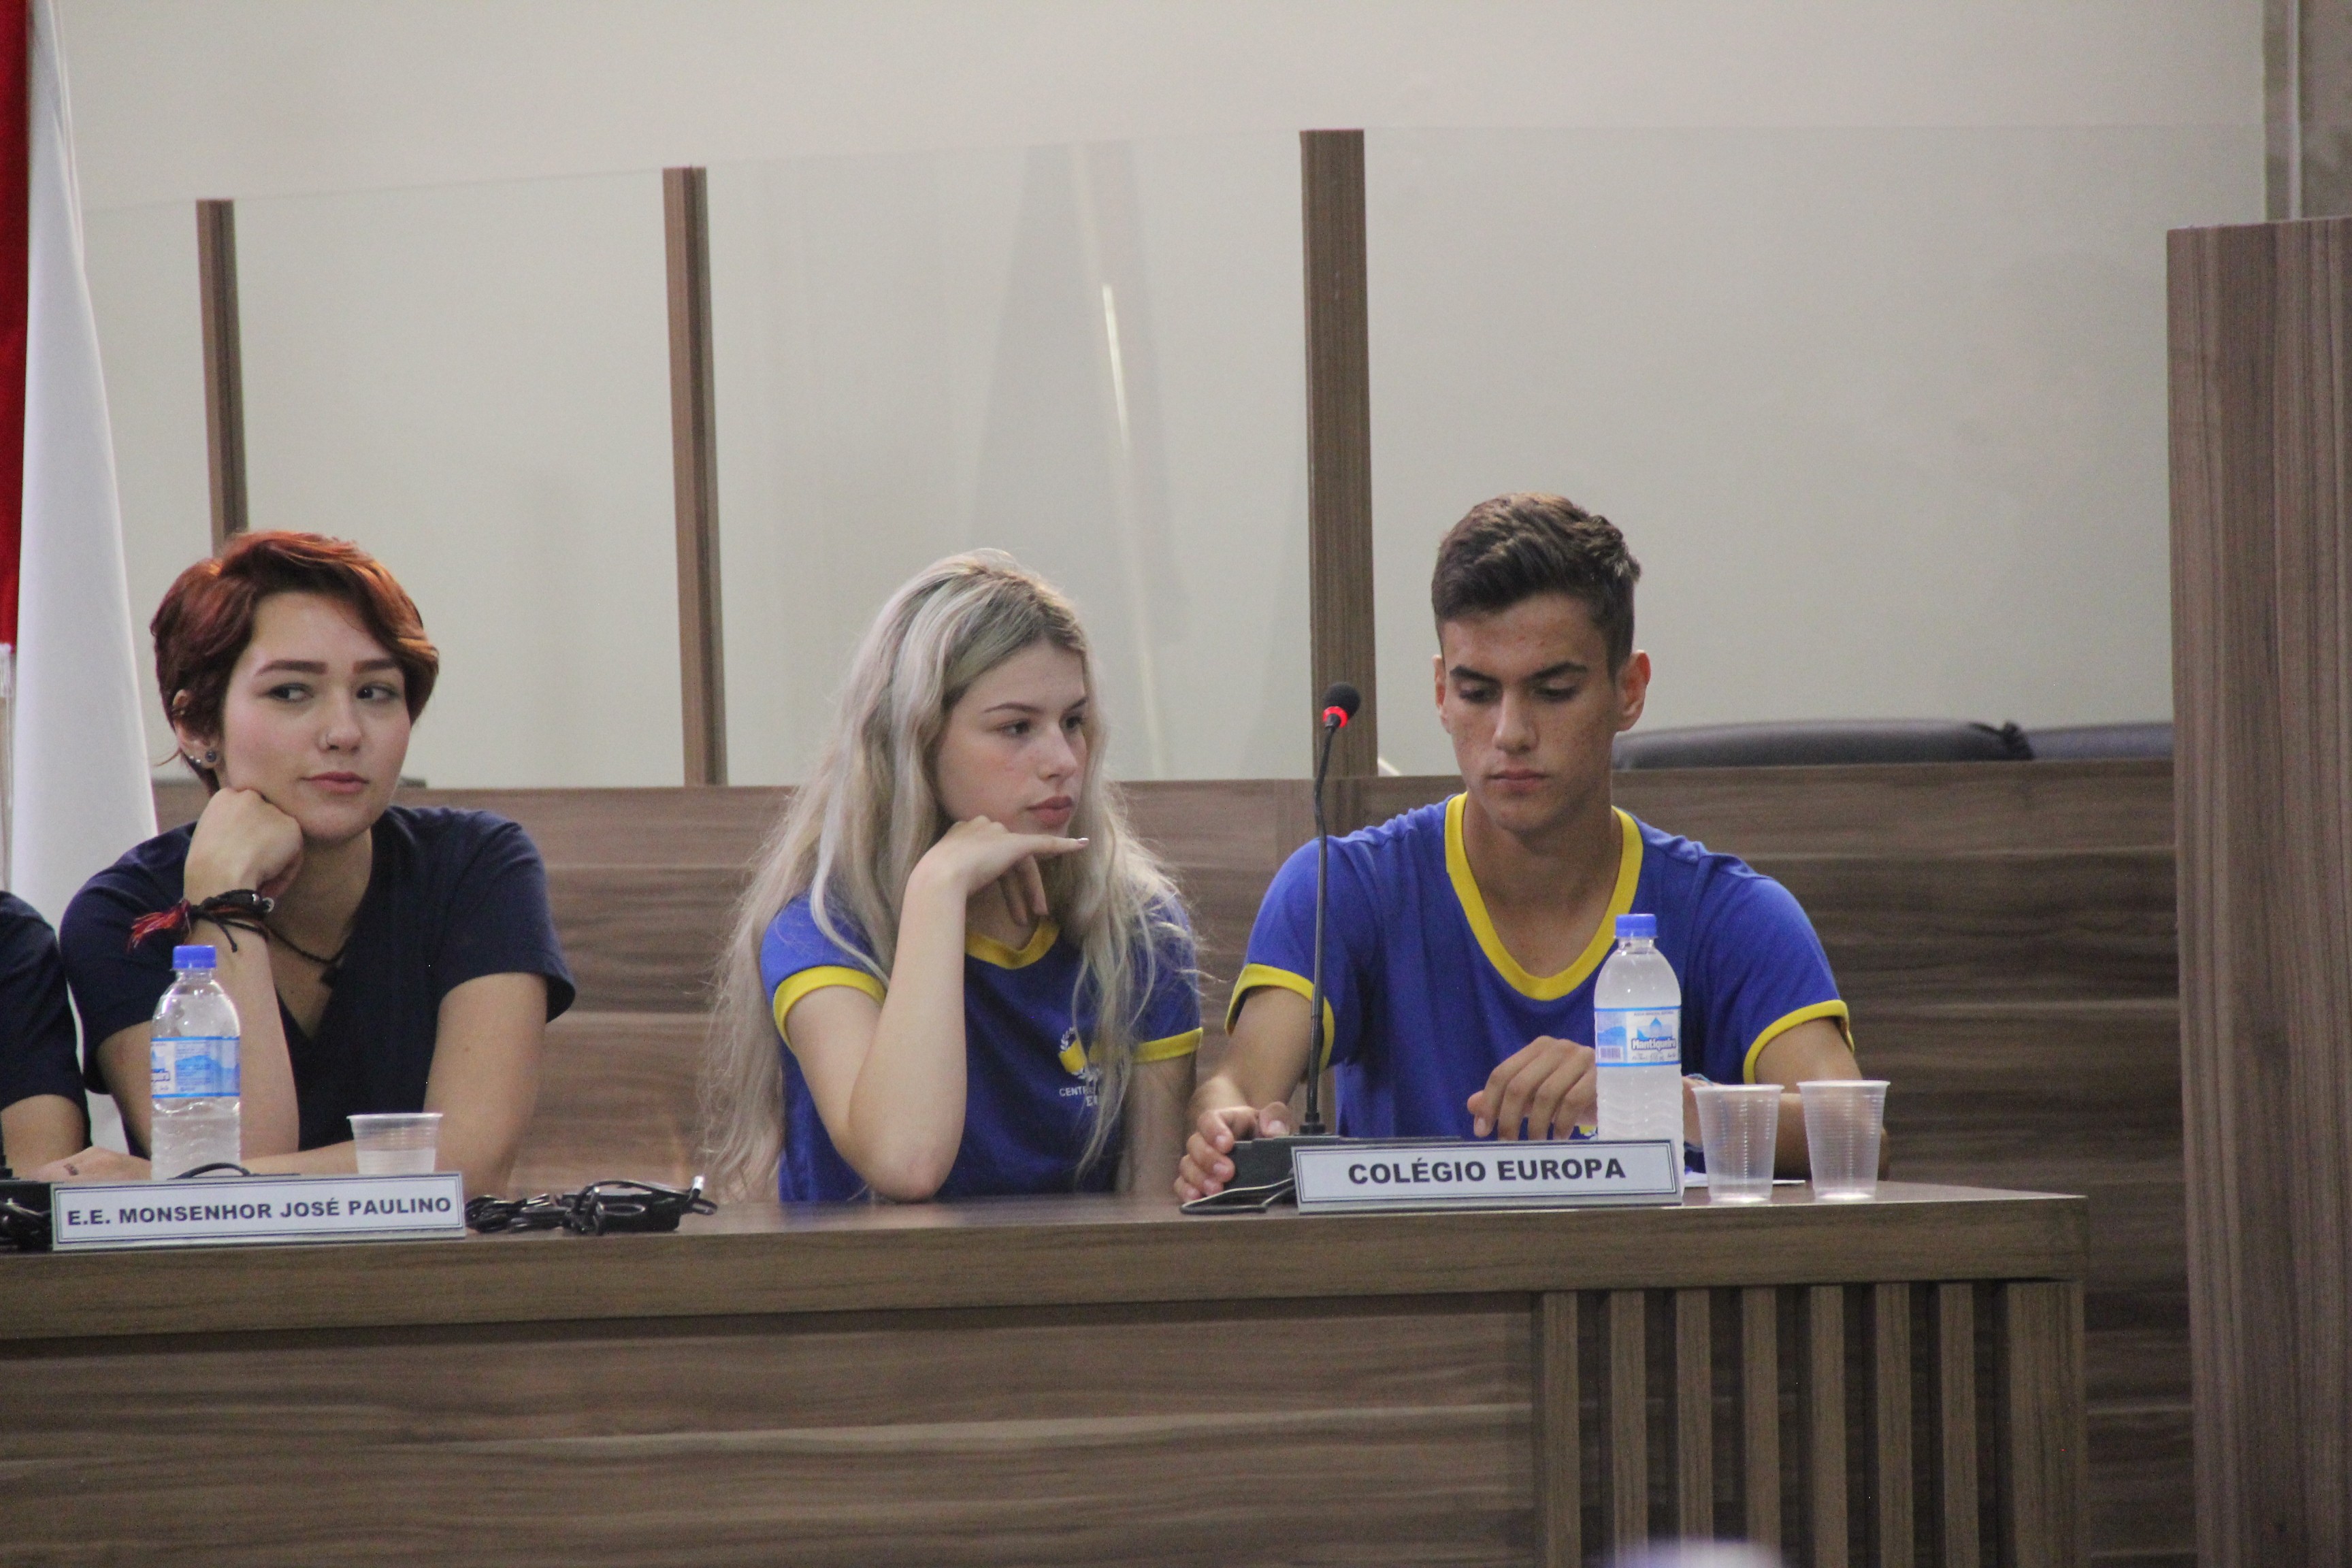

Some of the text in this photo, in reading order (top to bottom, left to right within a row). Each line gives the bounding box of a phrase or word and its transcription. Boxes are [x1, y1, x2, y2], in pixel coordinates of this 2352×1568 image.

[1348, 1158, 1626, 1184] COLÉGIO EUROPA
[68, 1197, 451, 1226] E.E. MONSENHOR JOSÉ PAULINO
